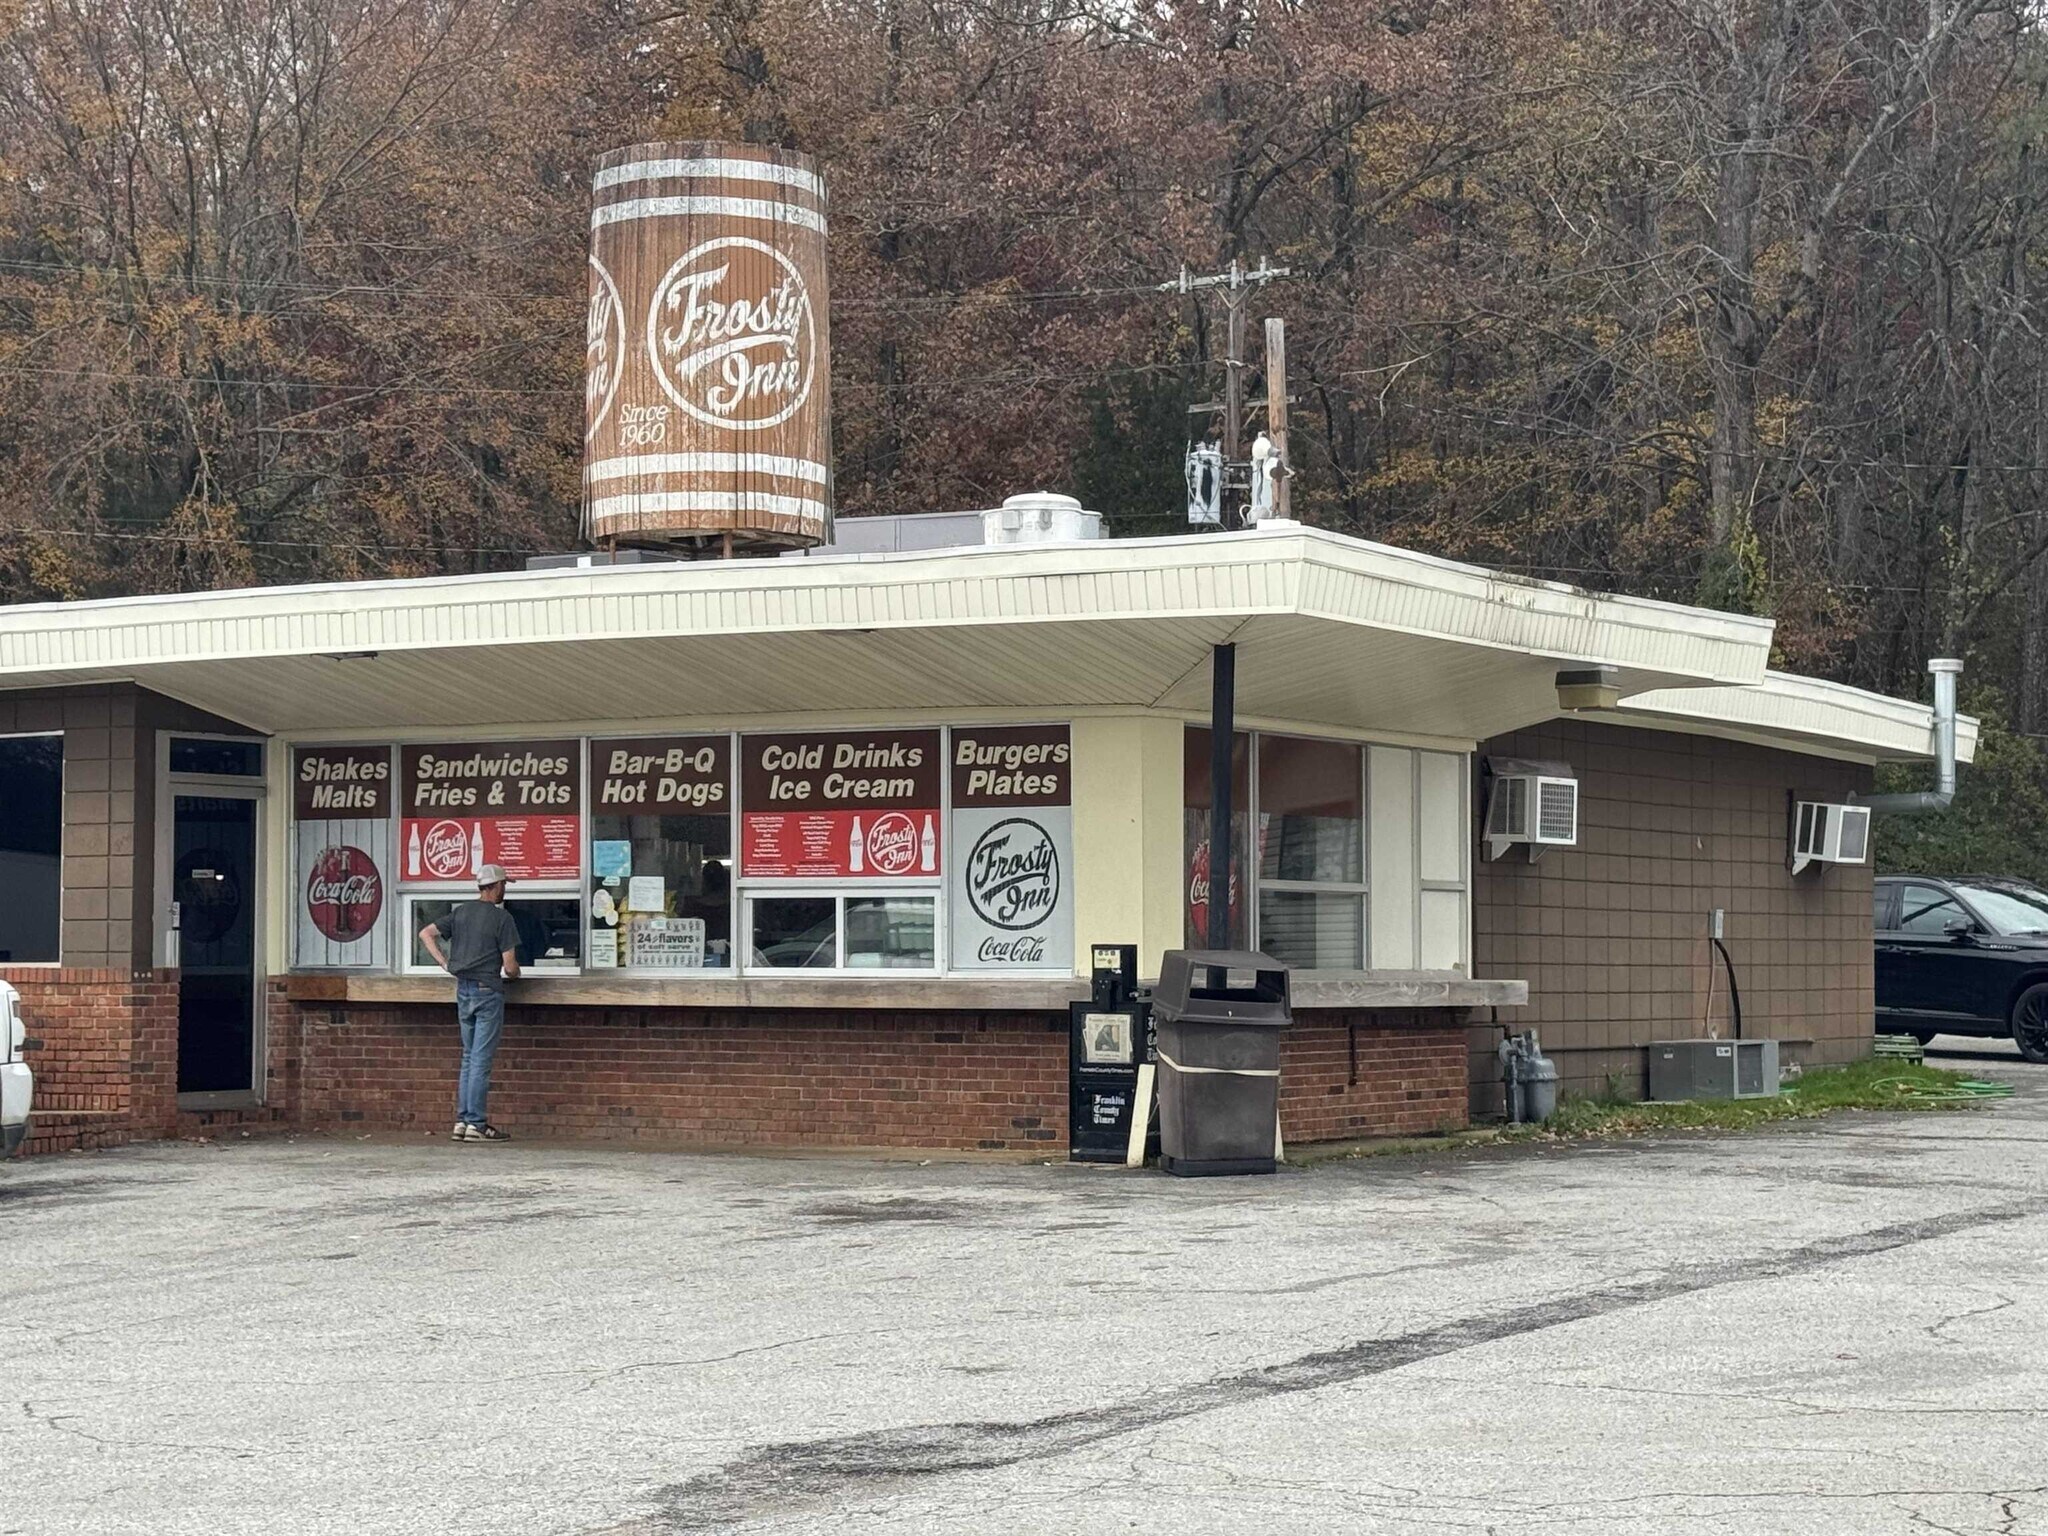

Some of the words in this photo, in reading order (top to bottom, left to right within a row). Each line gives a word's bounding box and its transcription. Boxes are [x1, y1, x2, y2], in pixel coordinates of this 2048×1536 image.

[663, 262, 808, 358] Frosty
[707, 352, 800, 416] Inn
[618, 403, 669, 424] Since
[619, 422, 666, 446] 1960
[416, 752, 570, 779] Sandwiches
[608, 747, 715, 774] Bar-B-Q
[761, 744, 825, 771] Cold
[833, 742, 923, 769] Drinks
[955, 740, 1069, 770] Burgers
[300, 756, 389, 783] Shakes
[967, 770, 1058, 796] Plates
[311, 785, 377, 808] Malts
[414, 783, 476, 806] Fries
[487, 781, 504, 805] &
[518, 780, 571, 803] Tots
[601, 779, 648, 803] Hot
[656, 778, 724, 807] Dogs
[769, 775, 811, 800] Ice
[823, 773, 915, 798] Cream
[427, 828, 465, 857] Frosty
[871, 821, 915, 852] Frosty
[438, 854, 464, 873] Inn
[884, 849, 913, 869] Inn
[974, 834, 1055, 890] Frosty
[998, 885, 1051, 923] Inn
[637, 933, 652, 943] 24
[659, 933, 694, 943] flavors
[1093, 1105, 1120, 1116] County
[1094, 1094, 1125, 1105] Franklin
[1093, 1114, 1115, 1124] Times
